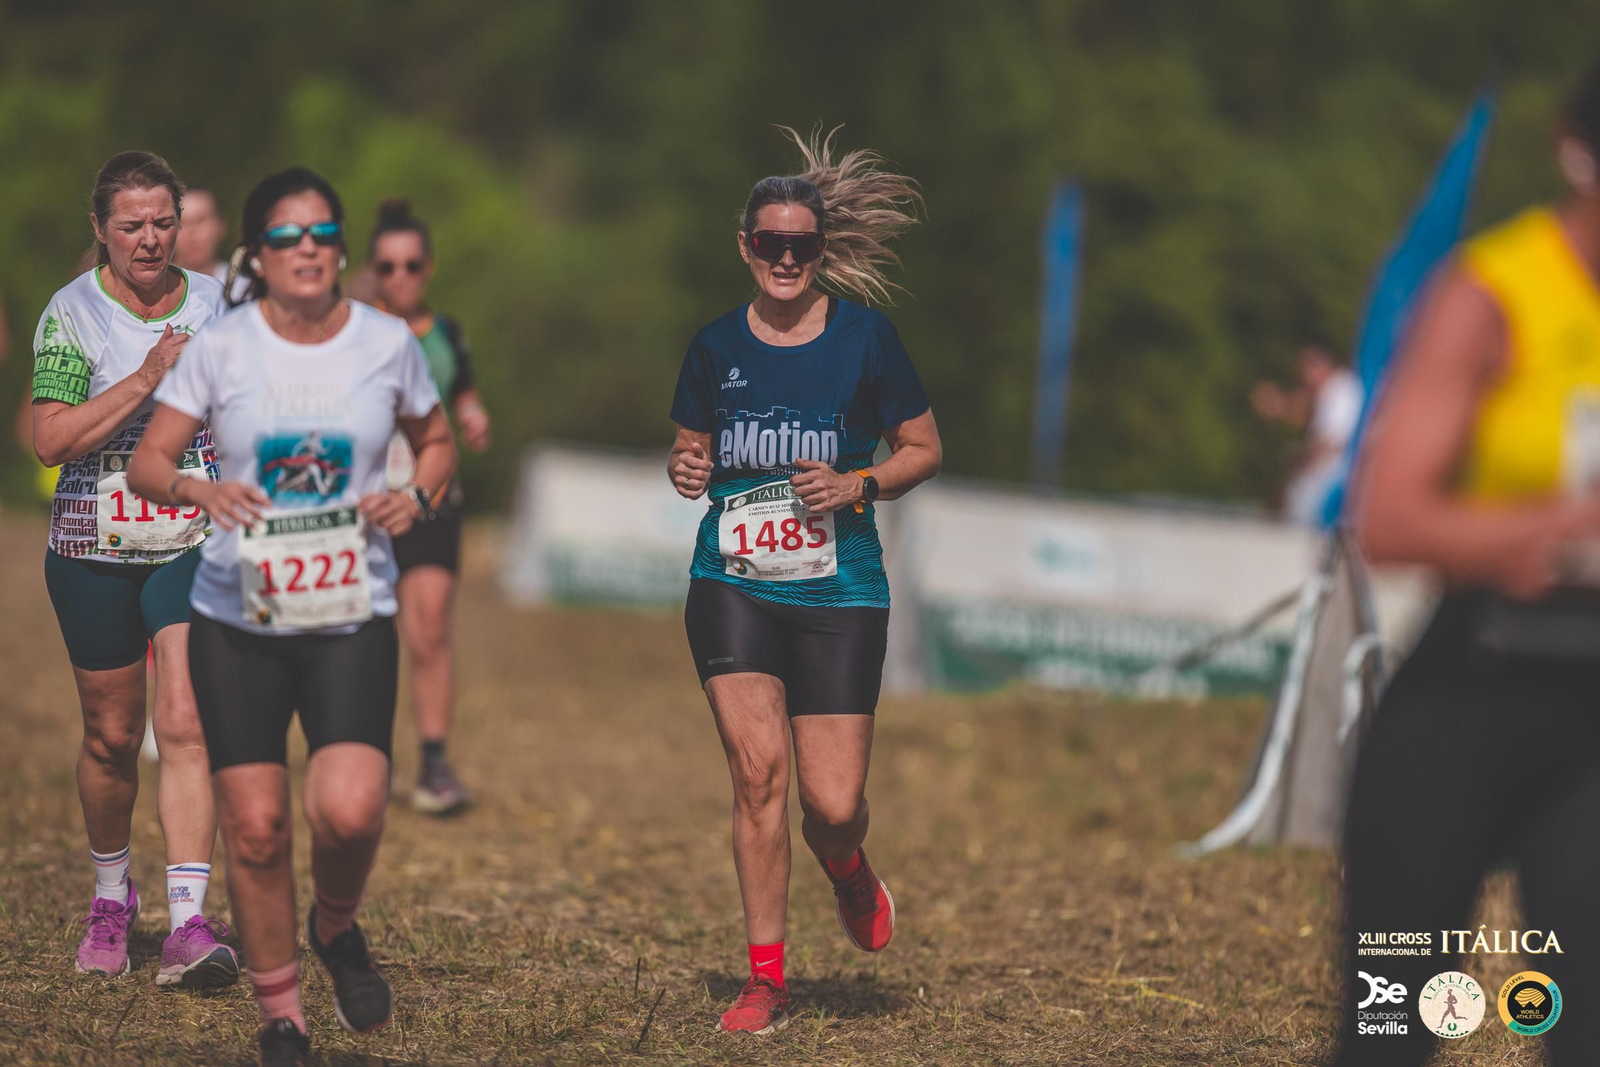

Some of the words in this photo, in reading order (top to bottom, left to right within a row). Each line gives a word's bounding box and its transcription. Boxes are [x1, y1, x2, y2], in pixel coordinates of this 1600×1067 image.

[721, 380, 748, 390] VIATOR
[719, 421, 838, 469] eMotion
[752, 485, 797, 501] ITÁLIC
[732, 515, 828, 556] 1485
[256, 548, 360, 597] 1222
